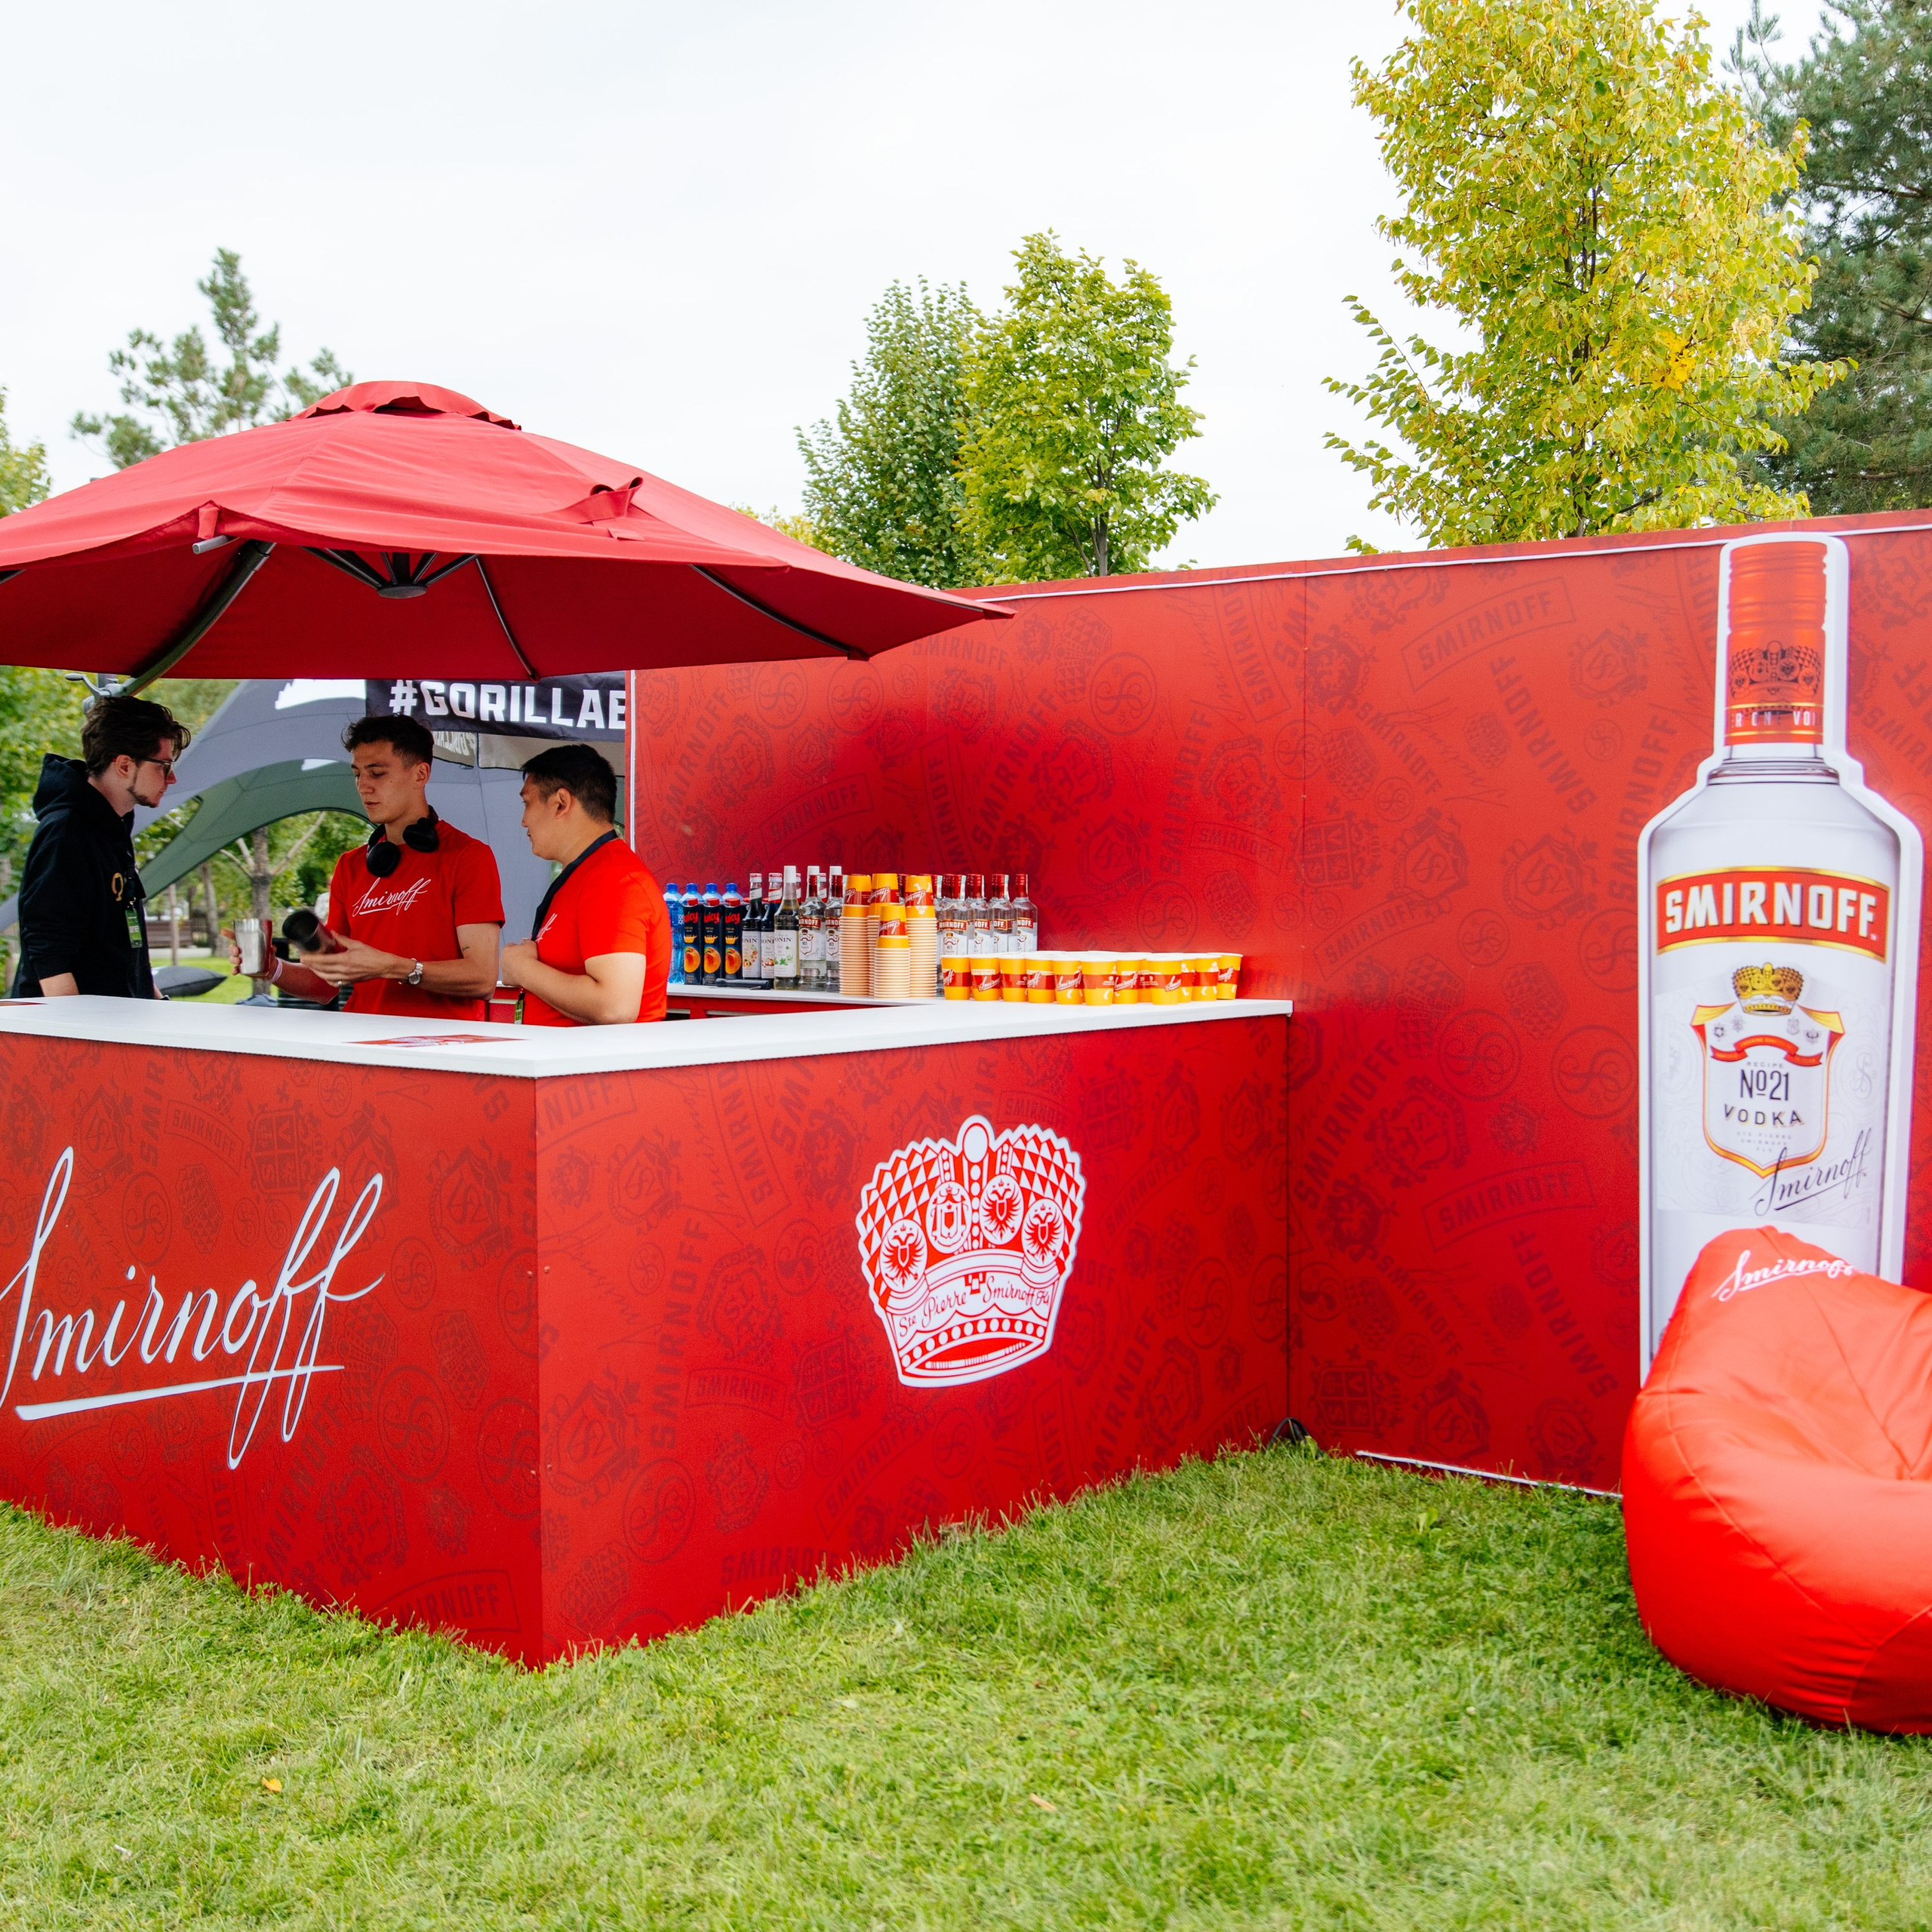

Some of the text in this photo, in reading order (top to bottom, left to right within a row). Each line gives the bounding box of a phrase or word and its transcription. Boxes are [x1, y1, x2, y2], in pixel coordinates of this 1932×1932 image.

[352, 877, 432, 917] Smirnoff
[1666, 882, 1877, 938] SMIRNOFF
[1724, 1104, 1802, 1126] VODKA
[1748, 1128, 1872, 1216] Smirnoff
[0, 1146, 386, 1471] Smirnoff
[921, 1291, 967, 1328] Pierre
[983, 1275, 1035, 1306] Smirnoff
